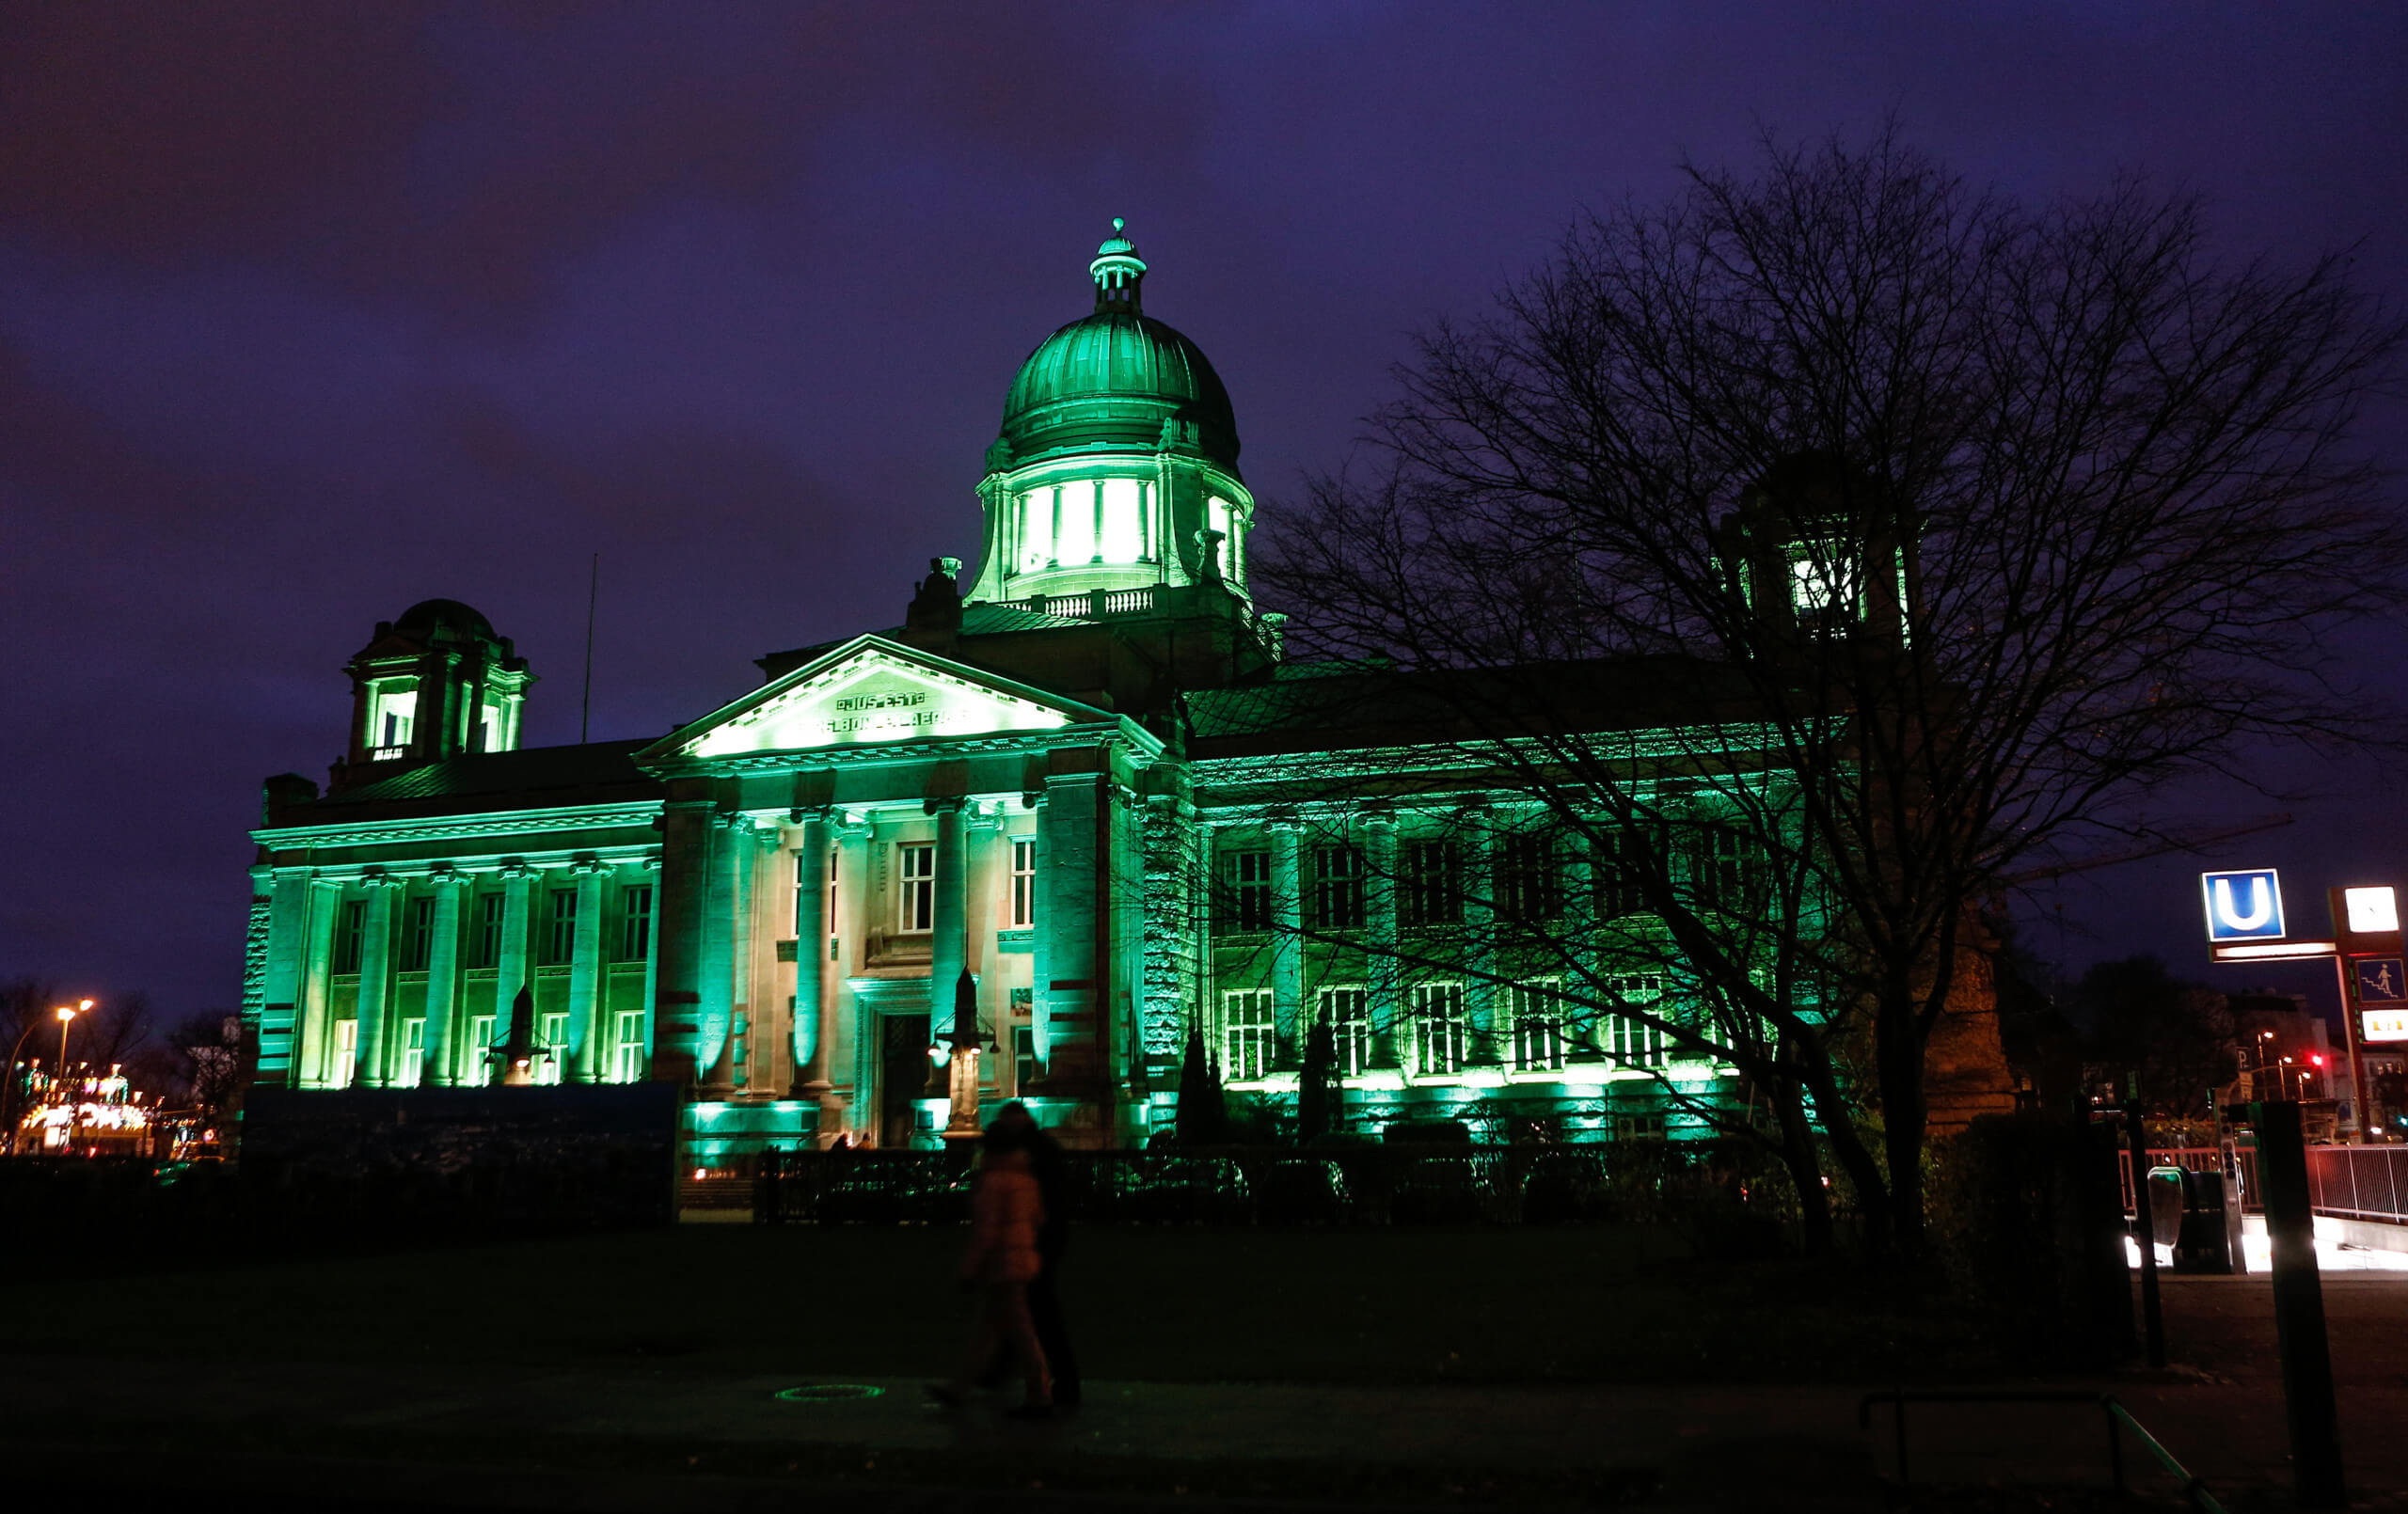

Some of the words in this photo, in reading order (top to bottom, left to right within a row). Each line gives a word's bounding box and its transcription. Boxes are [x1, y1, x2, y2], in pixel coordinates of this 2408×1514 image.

[884, 692, 916, 707] EST
[2214, 876, 2272, 931] U
[2238, 1049, 2247, 1069] P
